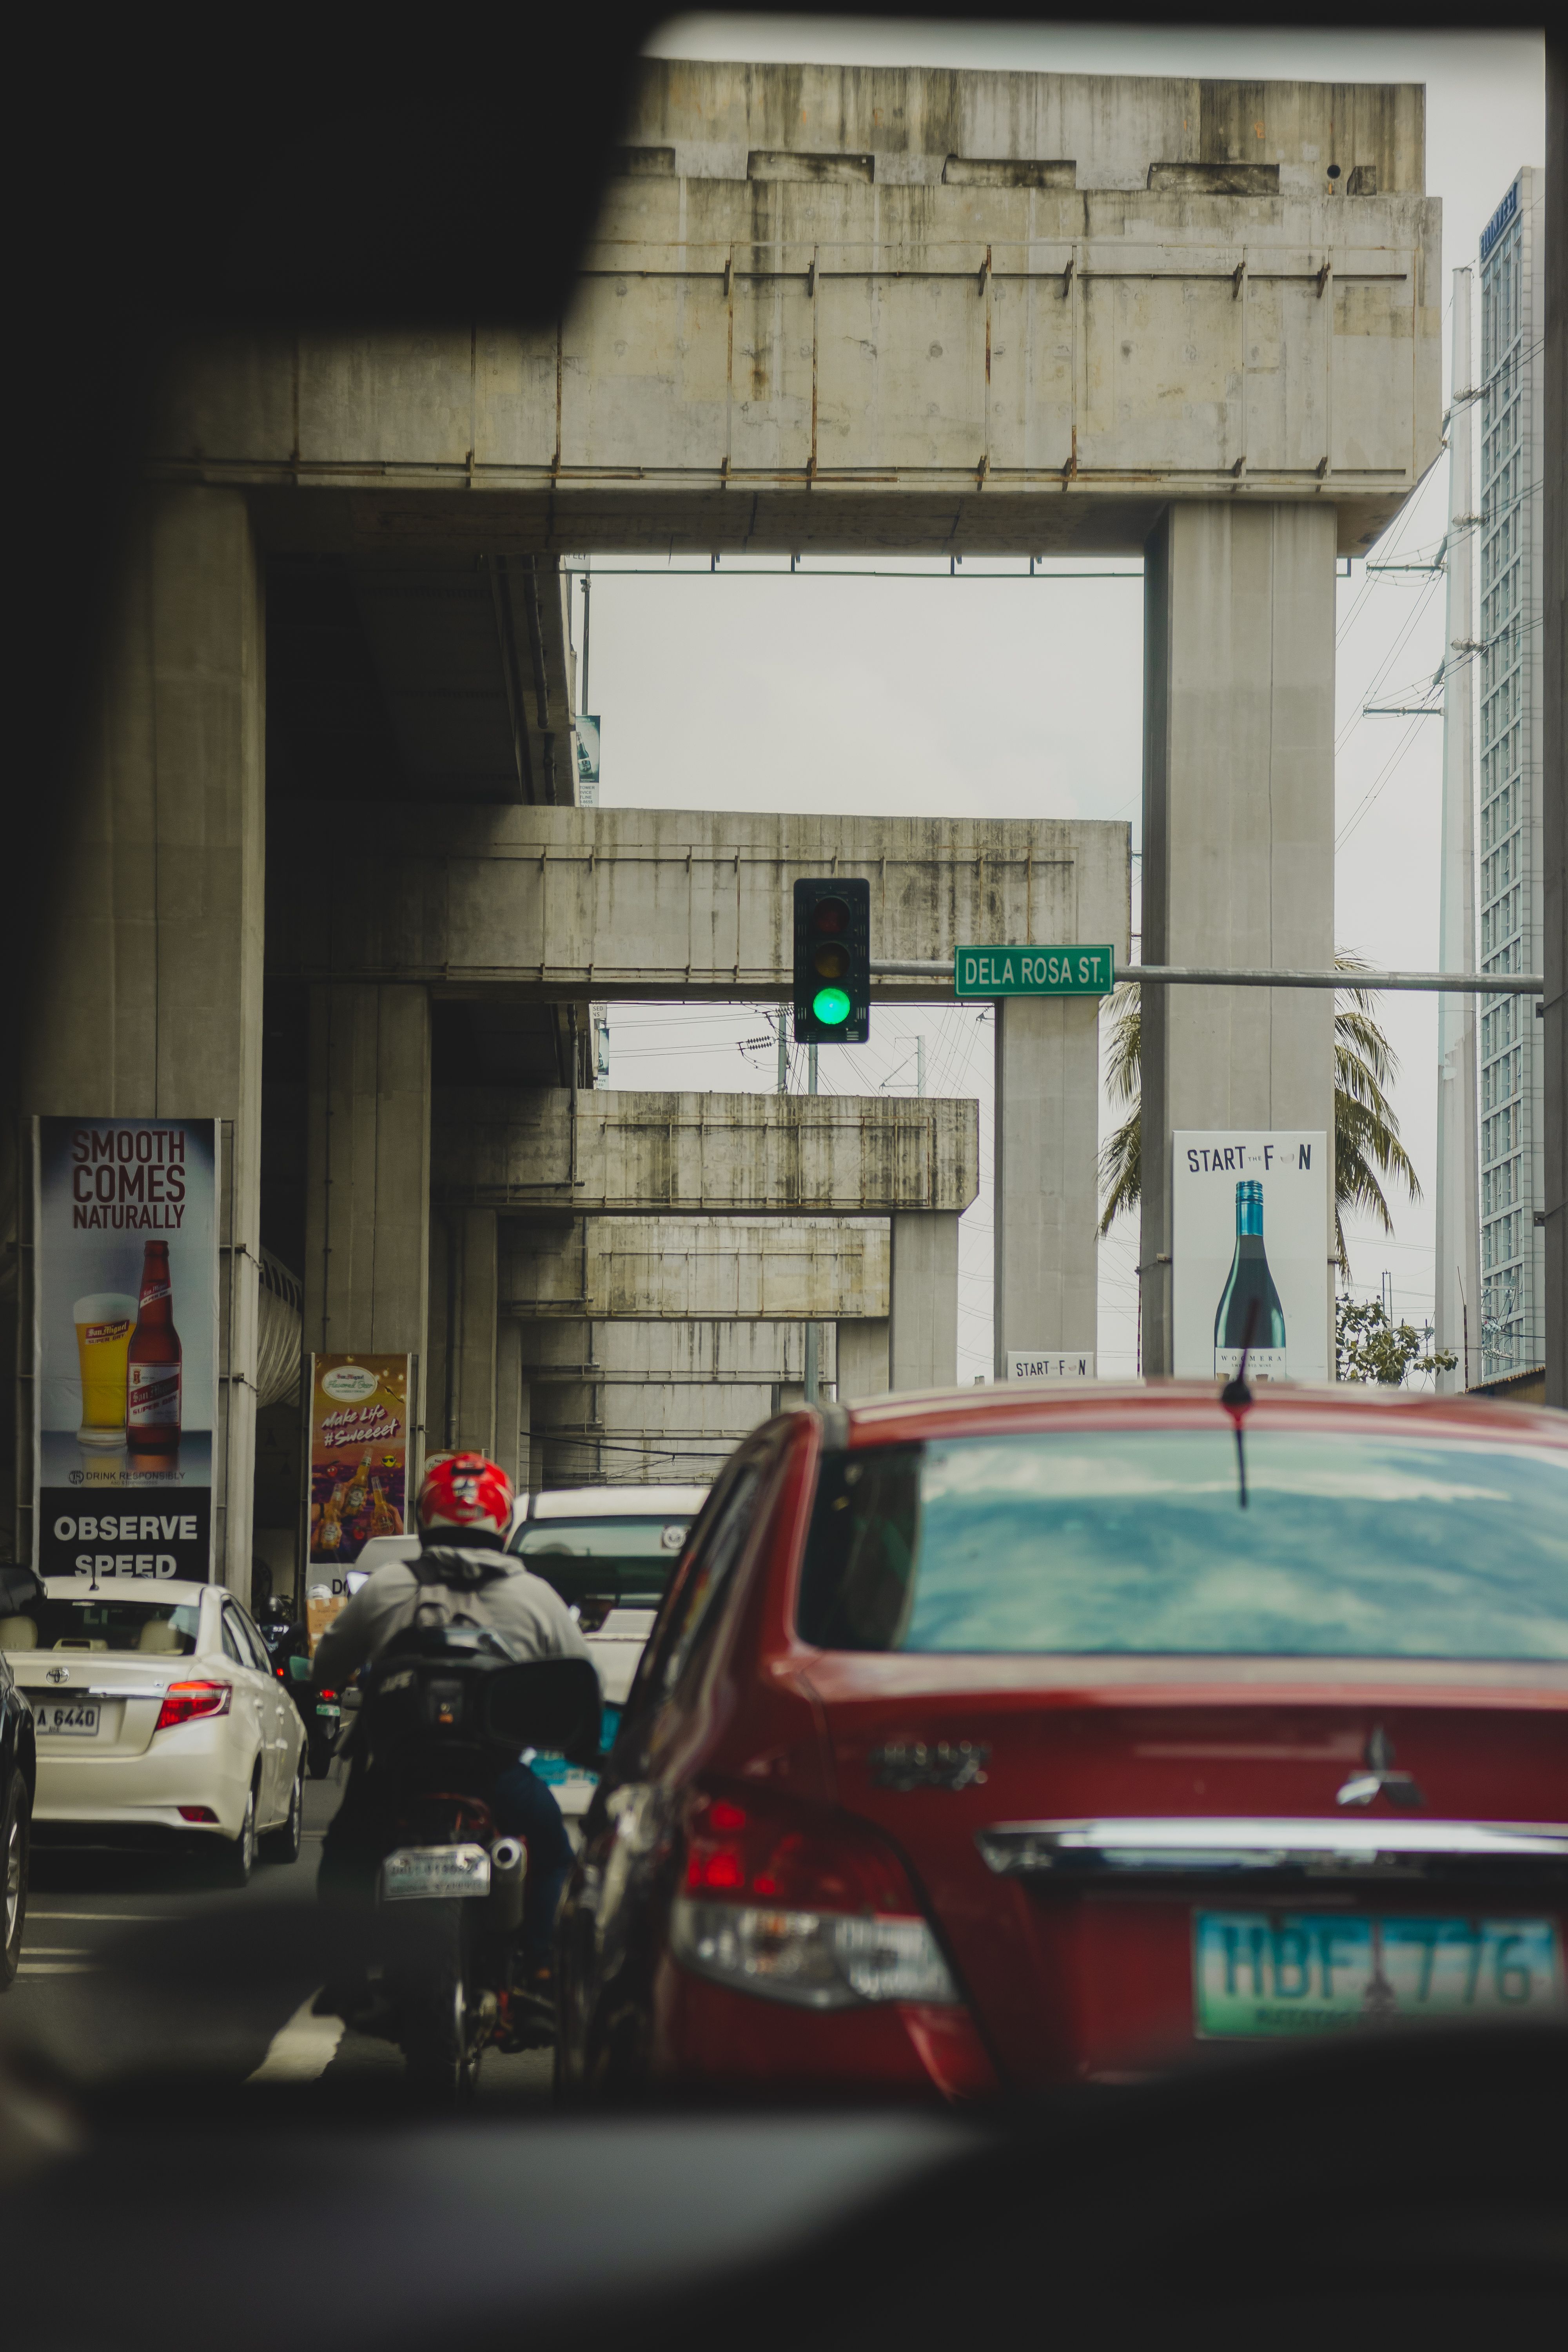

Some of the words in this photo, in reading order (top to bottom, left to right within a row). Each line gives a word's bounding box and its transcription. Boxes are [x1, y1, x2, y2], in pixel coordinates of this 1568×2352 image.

[965, 958, 1014, 984] DELA
[1022, 957, 1073, 984] ROSA
[1078, 956, 1104, 983] ST.
[72, 1130, 185, 1163] SMOOTH
[1187, 1146, 1246, 1172] START
[73, 1165, 185, 1202] COMES
[73, 1204, 185, 1229] NATURALLY
[1016, 1361, 1049, 1377] START
[321, 1408, 358, 1428] Make
[360, 1405, 386, 1425] Life
[324, 1418, 398, 1446] #Sweeeet
[86, 1472, 116, 1480] DRINK
[119, 1471, 185, 1481] RESPONSIBLY
[54, 1515, 197, 1541] OBSERVE
[74, 1555, 177, 1579] SPEED
[54, 1709, 95, 1726] 6440
[1222, 1926, 1356, 1998] HBF
[1397, 1932, 1531, 2005] 776
